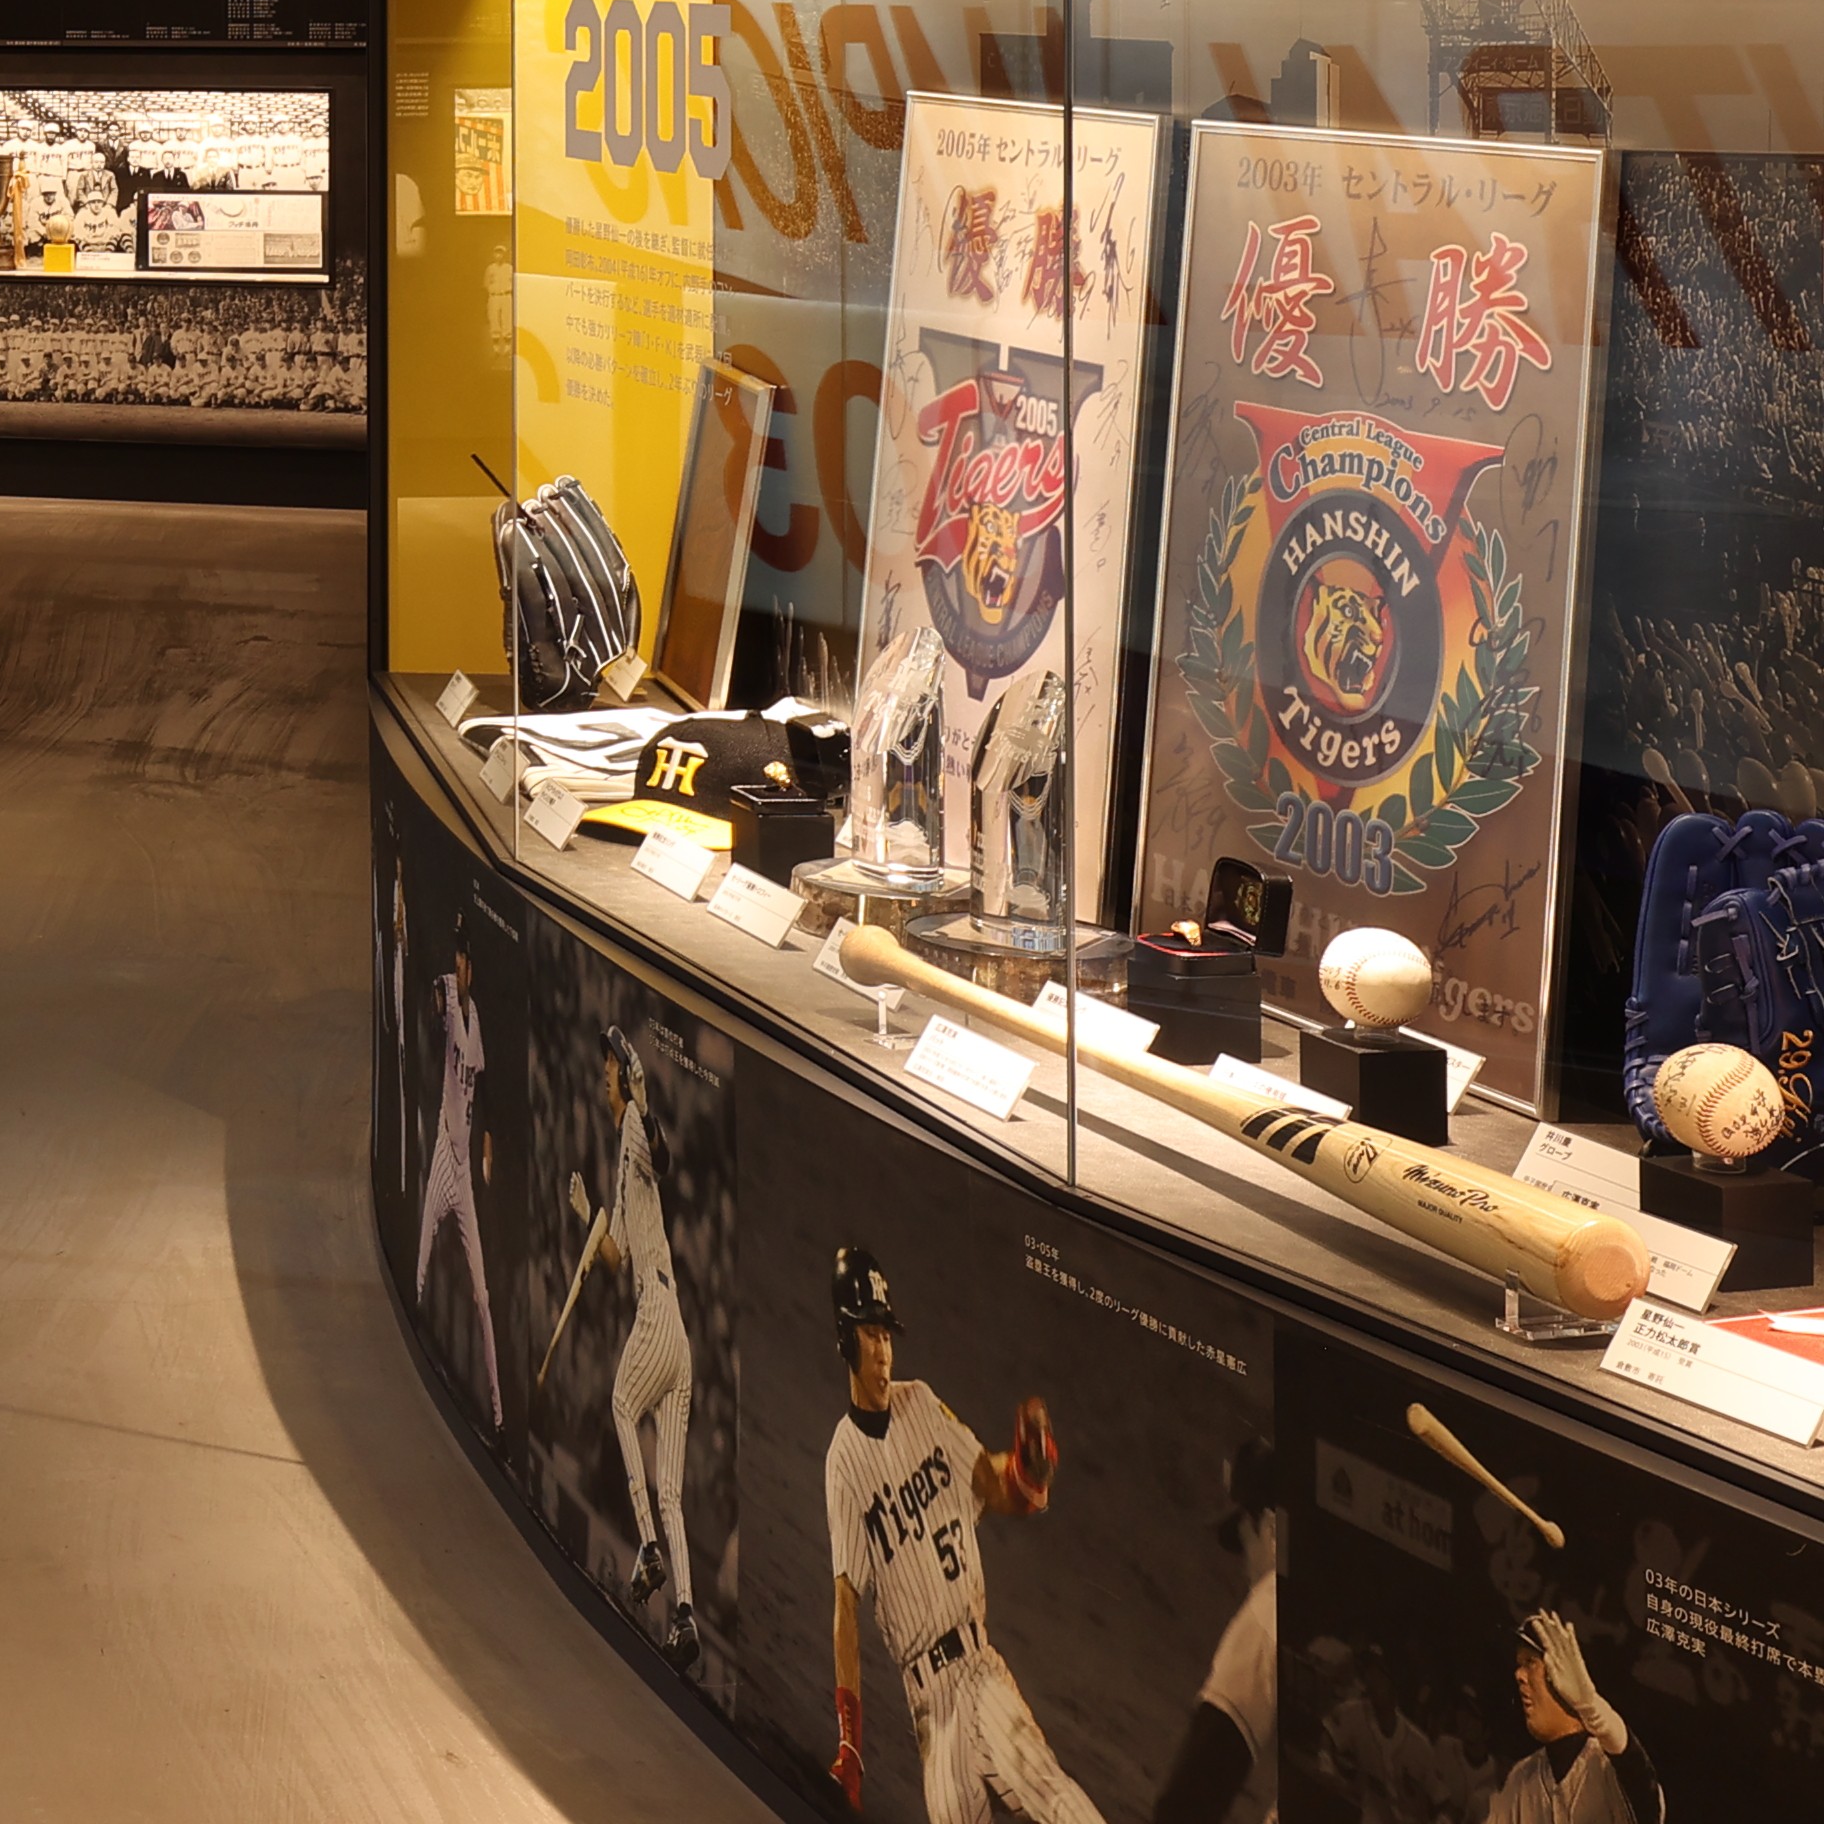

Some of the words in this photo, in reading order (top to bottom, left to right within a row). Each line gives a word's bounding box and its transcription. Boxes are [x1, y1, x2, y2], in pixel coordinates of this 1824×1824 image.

[936, 128, 992, 163] 2005年
[996, 141, 1122, 175] セントラルリーグ
[1237, 156, 1323, 196] 2003年
[1342, 164, 1557, 217] セントラル・リーグ
[1220, 214, 1552, 411] 優勝
[1016, 393, 1058, 436] 2005
[1299, 416, 1361, 446] Central
[1365, 421, 1424, 472] League
[1268, 444, 1447, 544] Champions
[1281, 509, 1420, 599] HANSHIN
[1278, 683, 1403, 770] Tigers
[1273, 791, 1394, 897] 2003
[1544, 1130, 1572, 1148] 井川慶
[1402, 1163, 1466, 1202] Mizuno
[1461, 1187, 1499, 1214] Pro
[1417, 1199, 1439, 1216] MAJOR
[1438, 1207, 1463, 1224] QUALITY
[1632, 1322, 1701, 1356] 正力松太郎賞
[1639, 1308, 1685, 1330] 星野仙一
[863, 1443, 951, 1565] Tigers
[1645, 1568, 1781, 1640] 03年の日本シリーズ
[1646, 1617, 1707, 1658] 広澤克実
